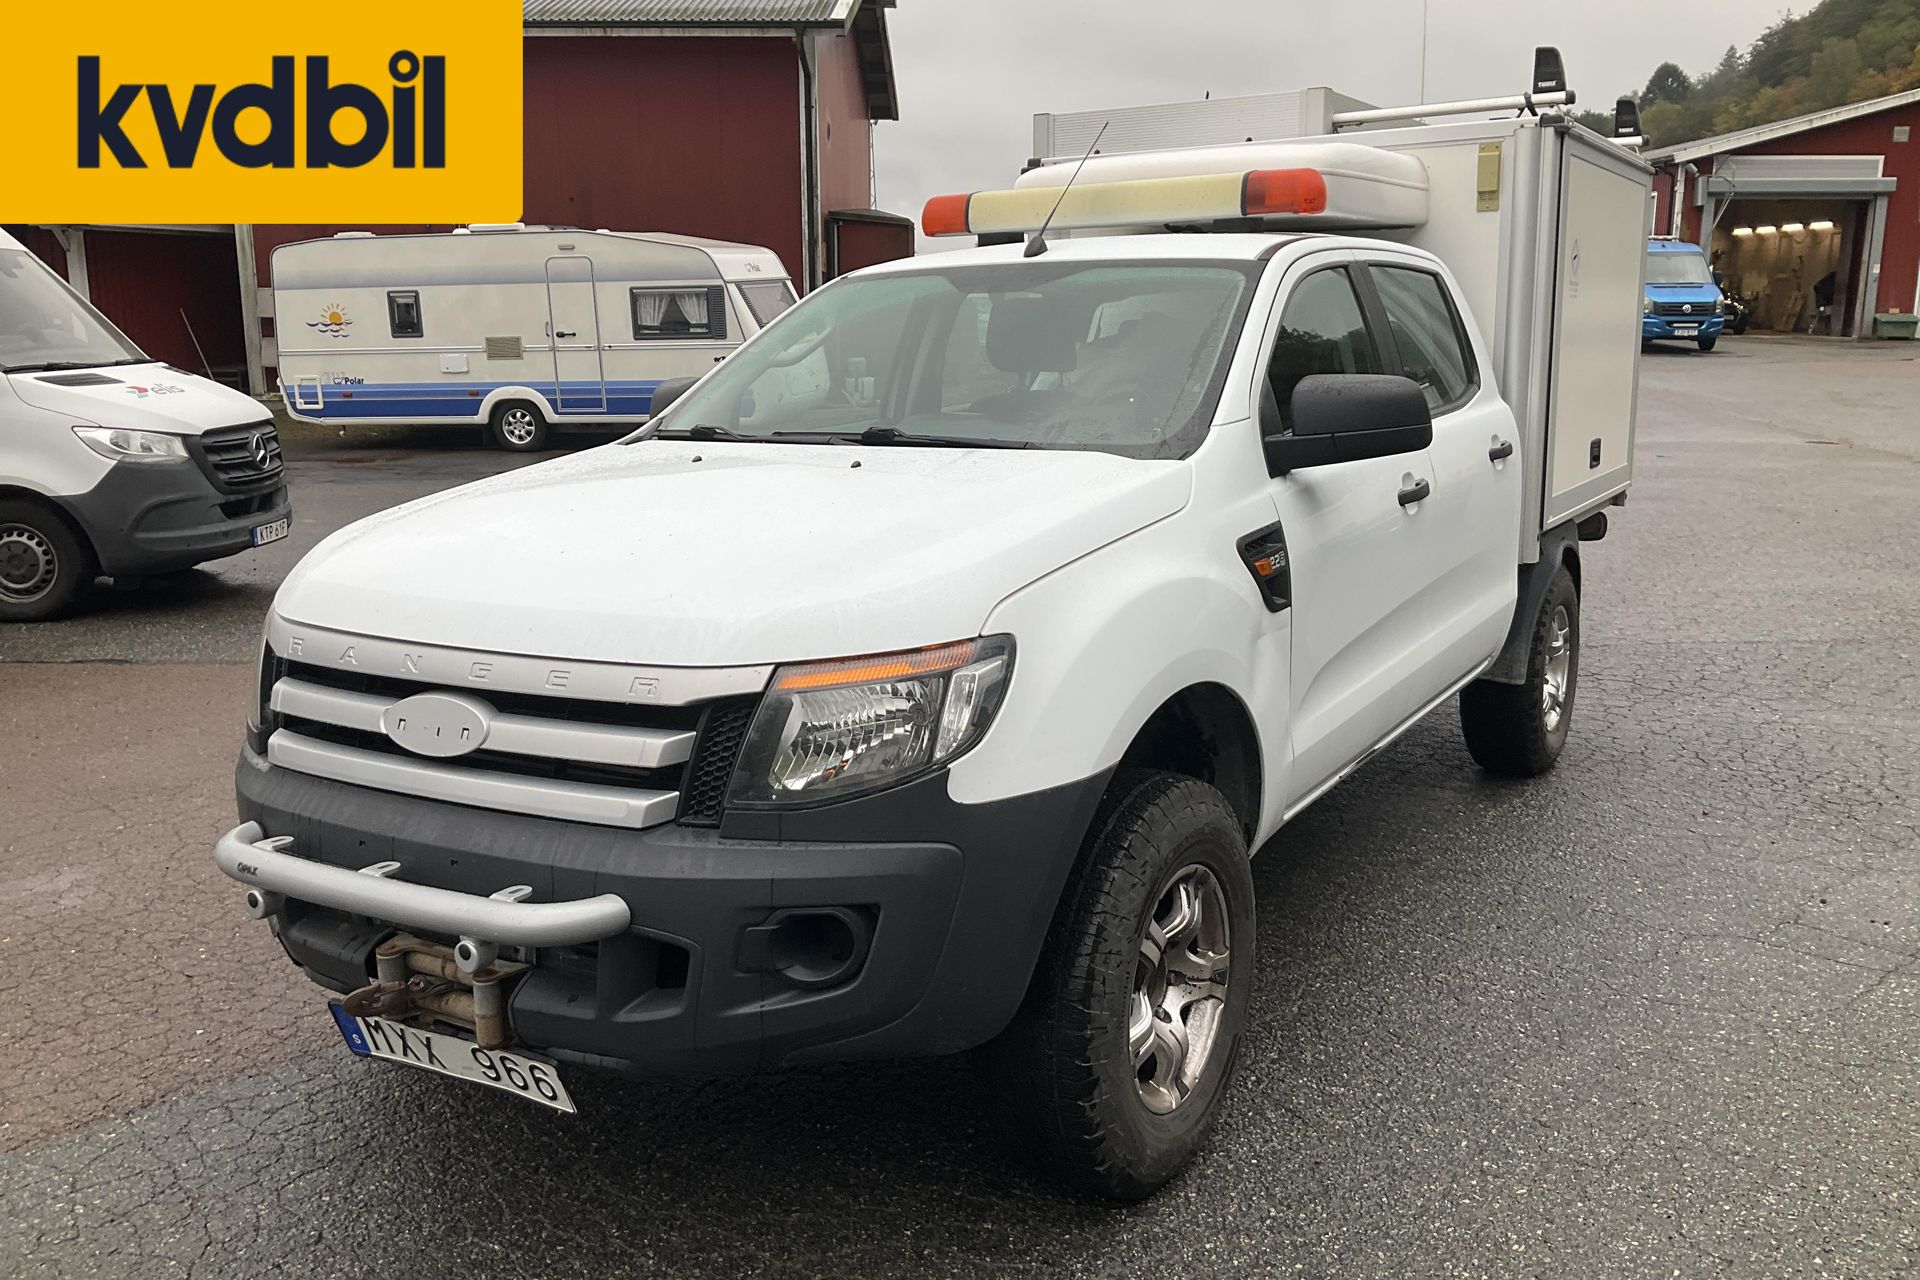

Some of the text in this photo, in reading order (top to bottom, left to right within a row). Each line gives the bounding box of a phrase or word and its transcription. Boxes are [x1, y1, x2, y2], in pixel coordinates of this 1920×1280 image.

[1538, 80, 1557, 88] THULE
[344, 376, 365, 385] Polar
[151, 383, 187, 395] elis
[260, 524, 274, 542] KTP
[288, 636, 661, 697] RANGER
[352, 1033, 362, 1045] S
[363, 1016, 558, 1101] MXX 966
